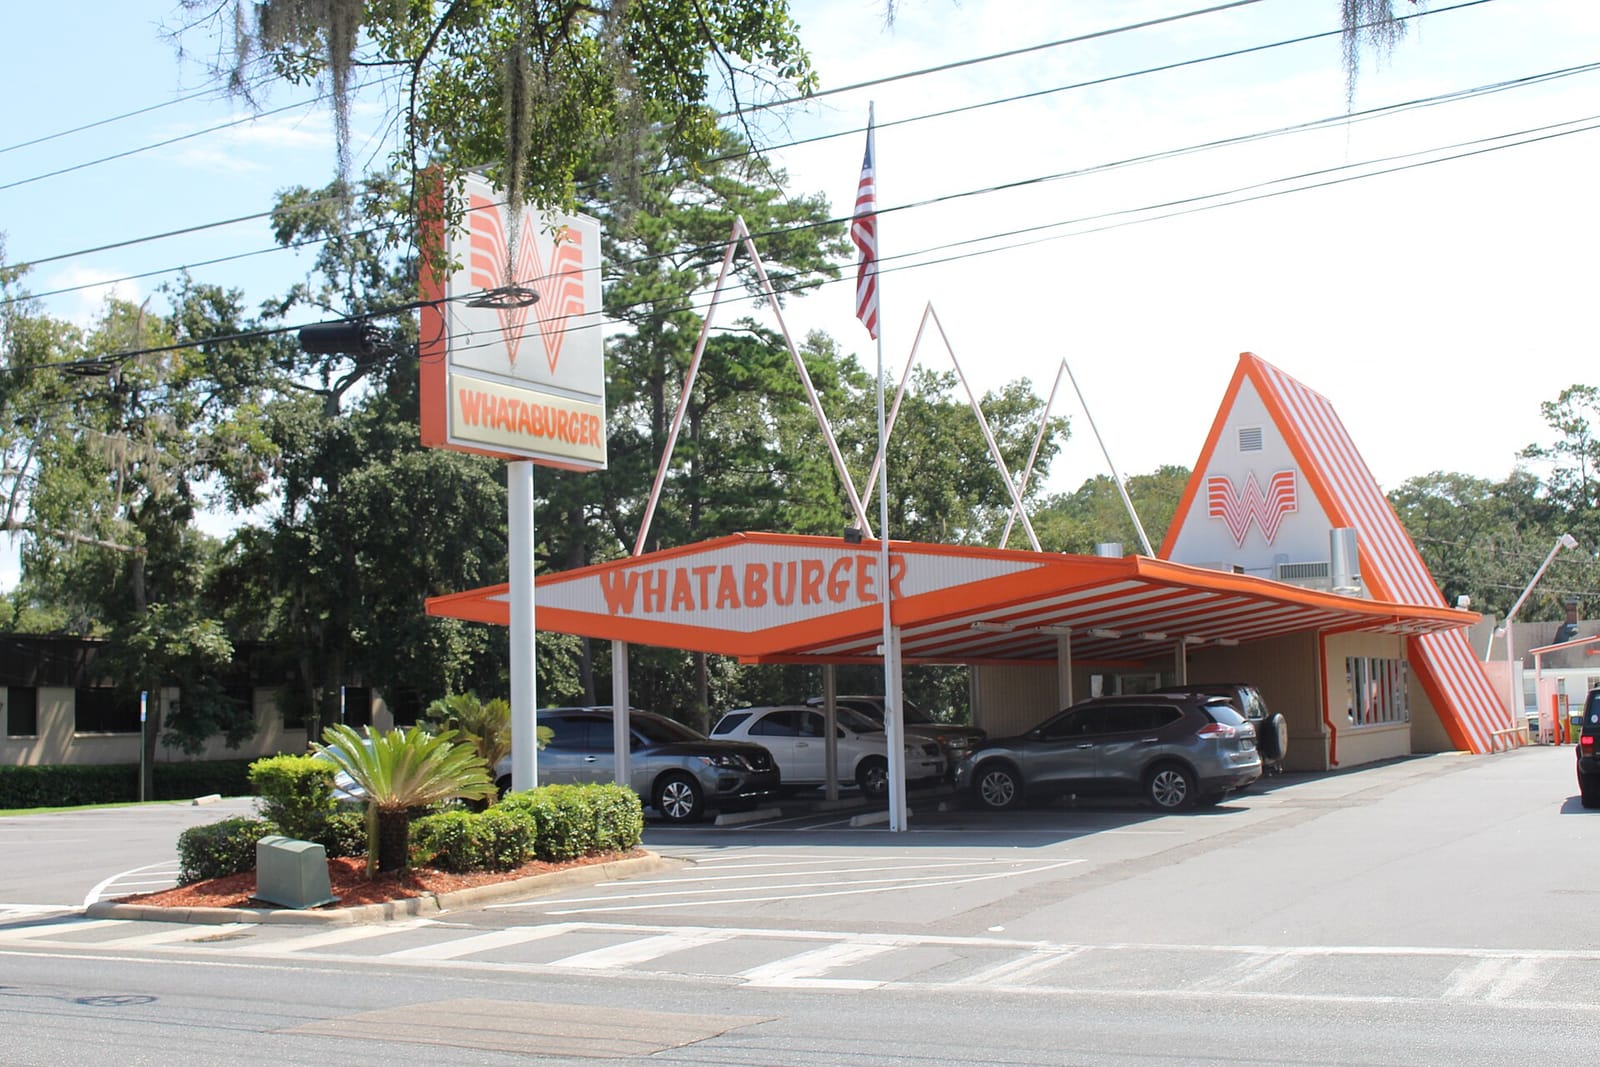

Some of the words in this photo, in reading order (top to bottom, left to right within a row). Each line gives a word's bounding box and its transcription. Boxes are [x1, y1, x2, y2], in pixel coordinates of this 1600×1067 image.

[459, 389, 601, 449] WHATABURGER
[1207, 469, 1298, 549] W
[600, 554, 906, 616] WHATABURGER
